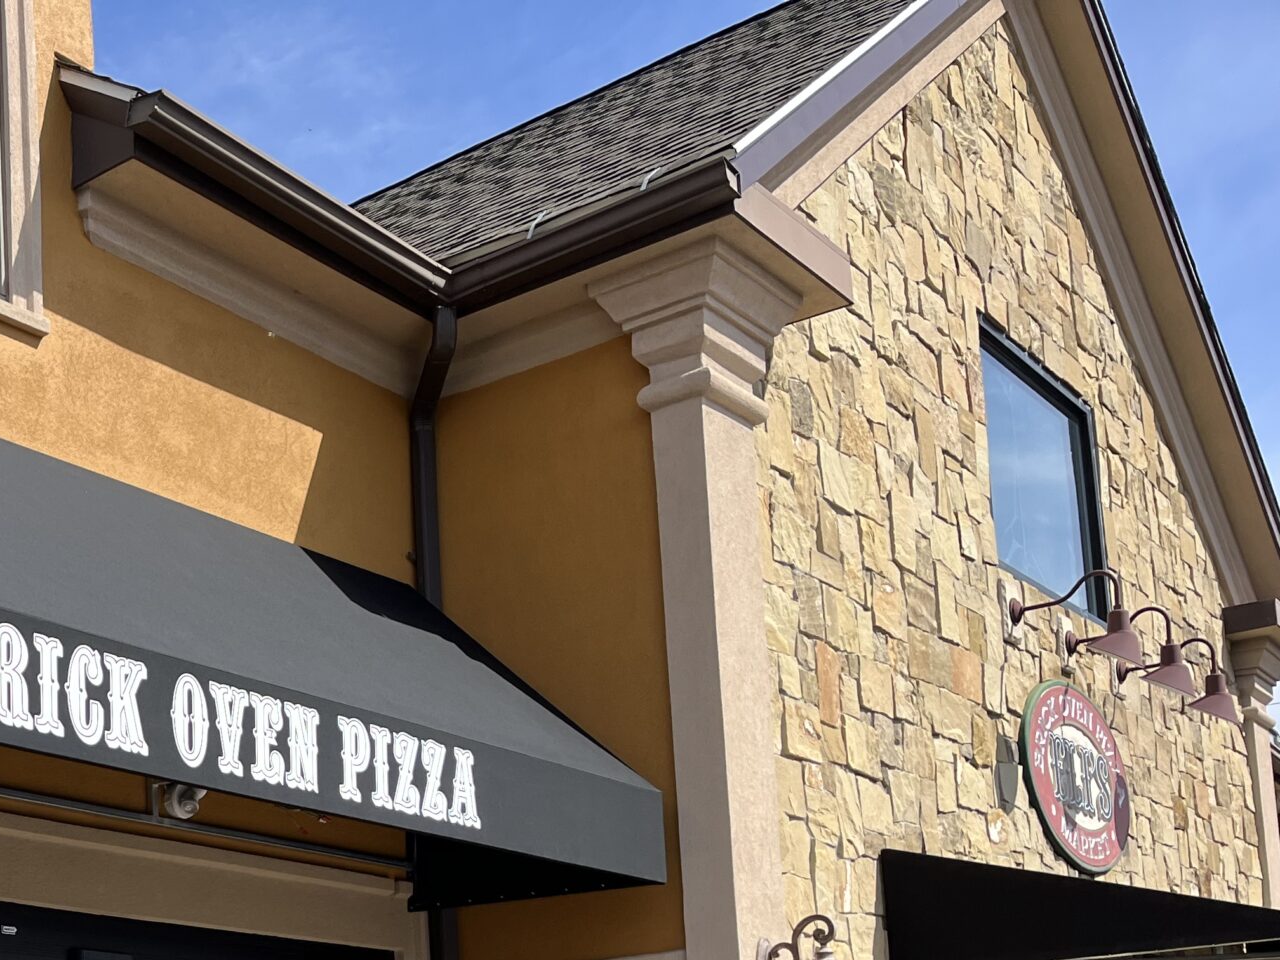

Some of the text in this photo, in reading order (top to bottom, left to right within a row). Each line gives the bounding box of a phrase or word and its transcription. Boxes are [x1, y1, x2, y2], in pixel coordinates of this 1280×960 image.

[170, 673, 320, 793] OVEN
[337, 715, 482, 830] PIZZA
[1060, 815, 1110, 860] MARKET
